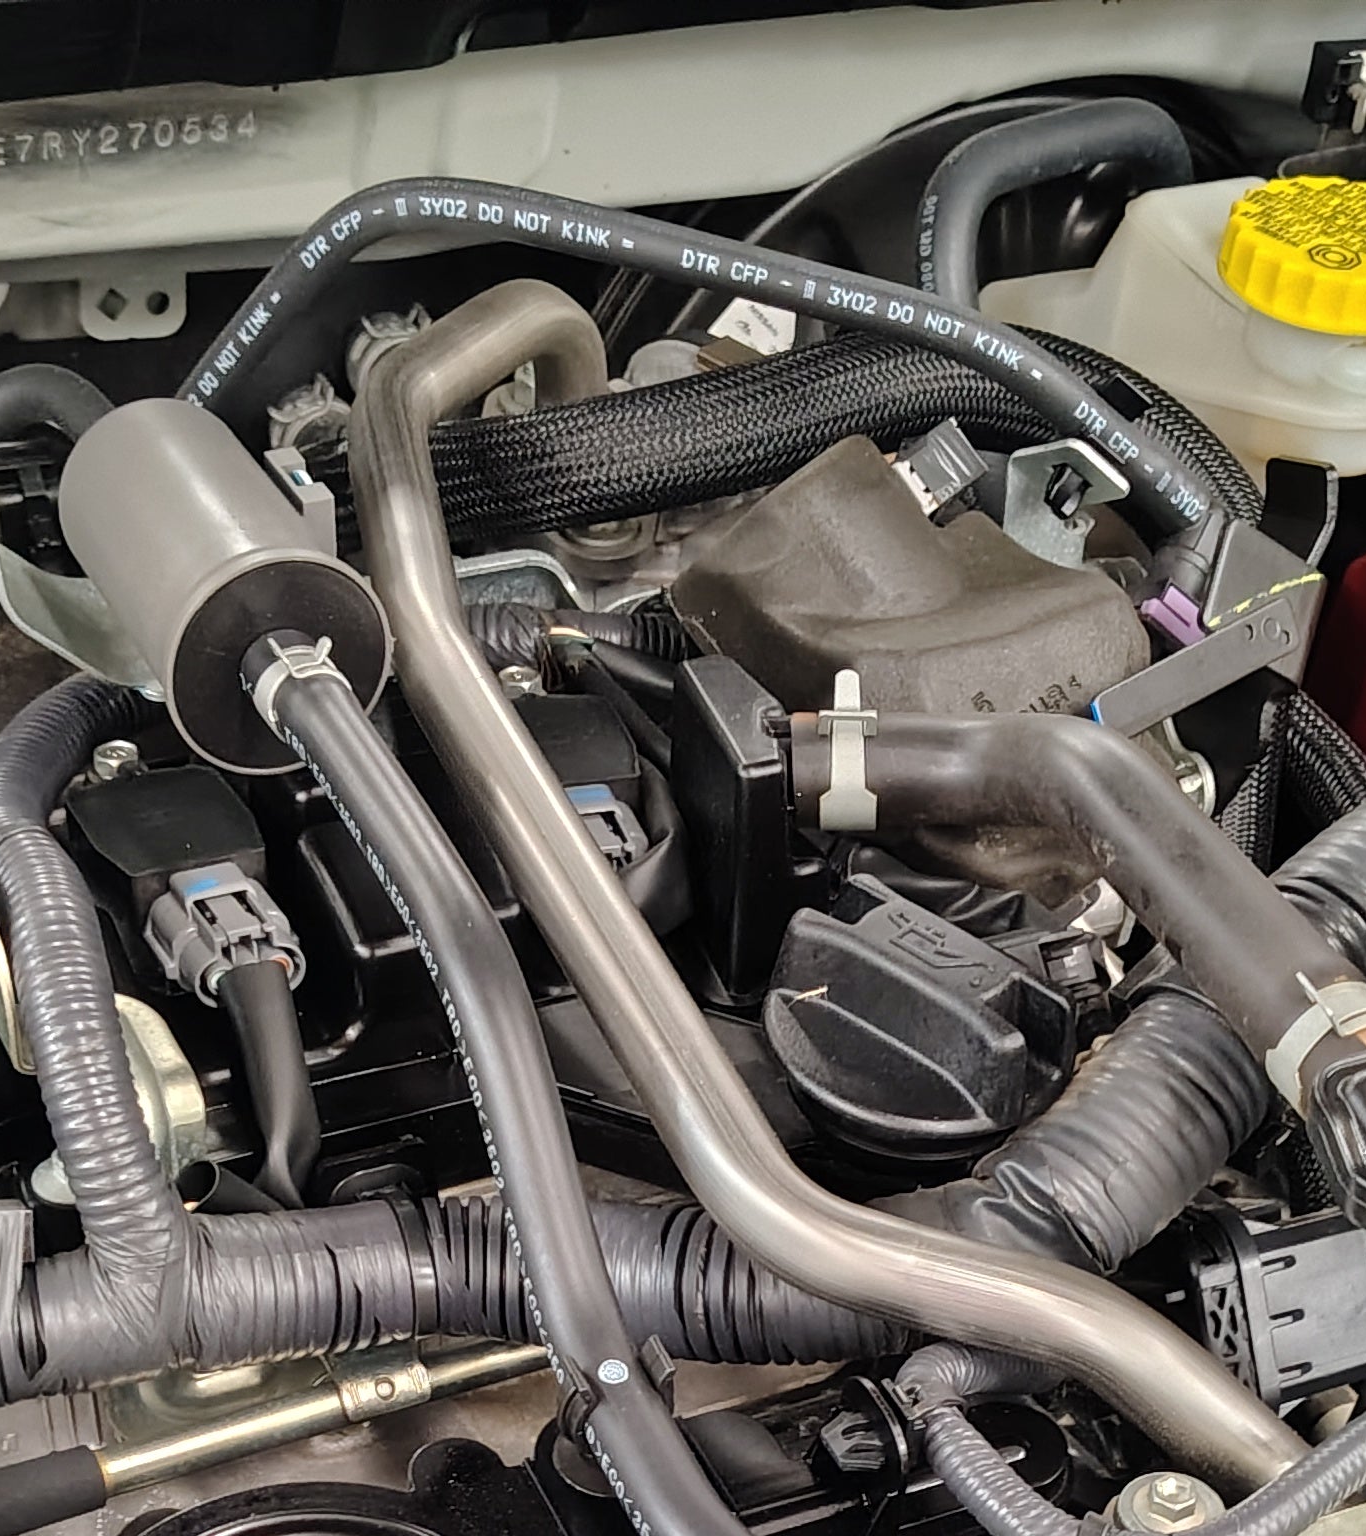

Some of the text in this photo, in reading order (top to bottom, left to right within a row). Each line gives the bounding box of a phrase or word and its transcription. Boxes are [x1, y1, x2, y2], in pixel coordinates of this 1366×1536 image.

[299, 235, 332, 270] DTR
[330, 210, 363, 242] CFP
[478, 203, 504, 224] DO
[513, 209, 552, 234] NOT
[561, 220, 611, 249] KINK
[680, 247, 720, 276] DTR
[729, 261, 769, 286] CFP
[888, 300, 915, 325] DO
[924, 313, 965, 340] NOT
[973, 331, 1025, 373] KINK
[200, 370, 219, 400] DO
[213, 340, 243, 376] NOT
[236, 306, 275, 345] KINK
[1074, 401, 1107, 436] DTR
[1108, 431, 1140, 460] CFP
